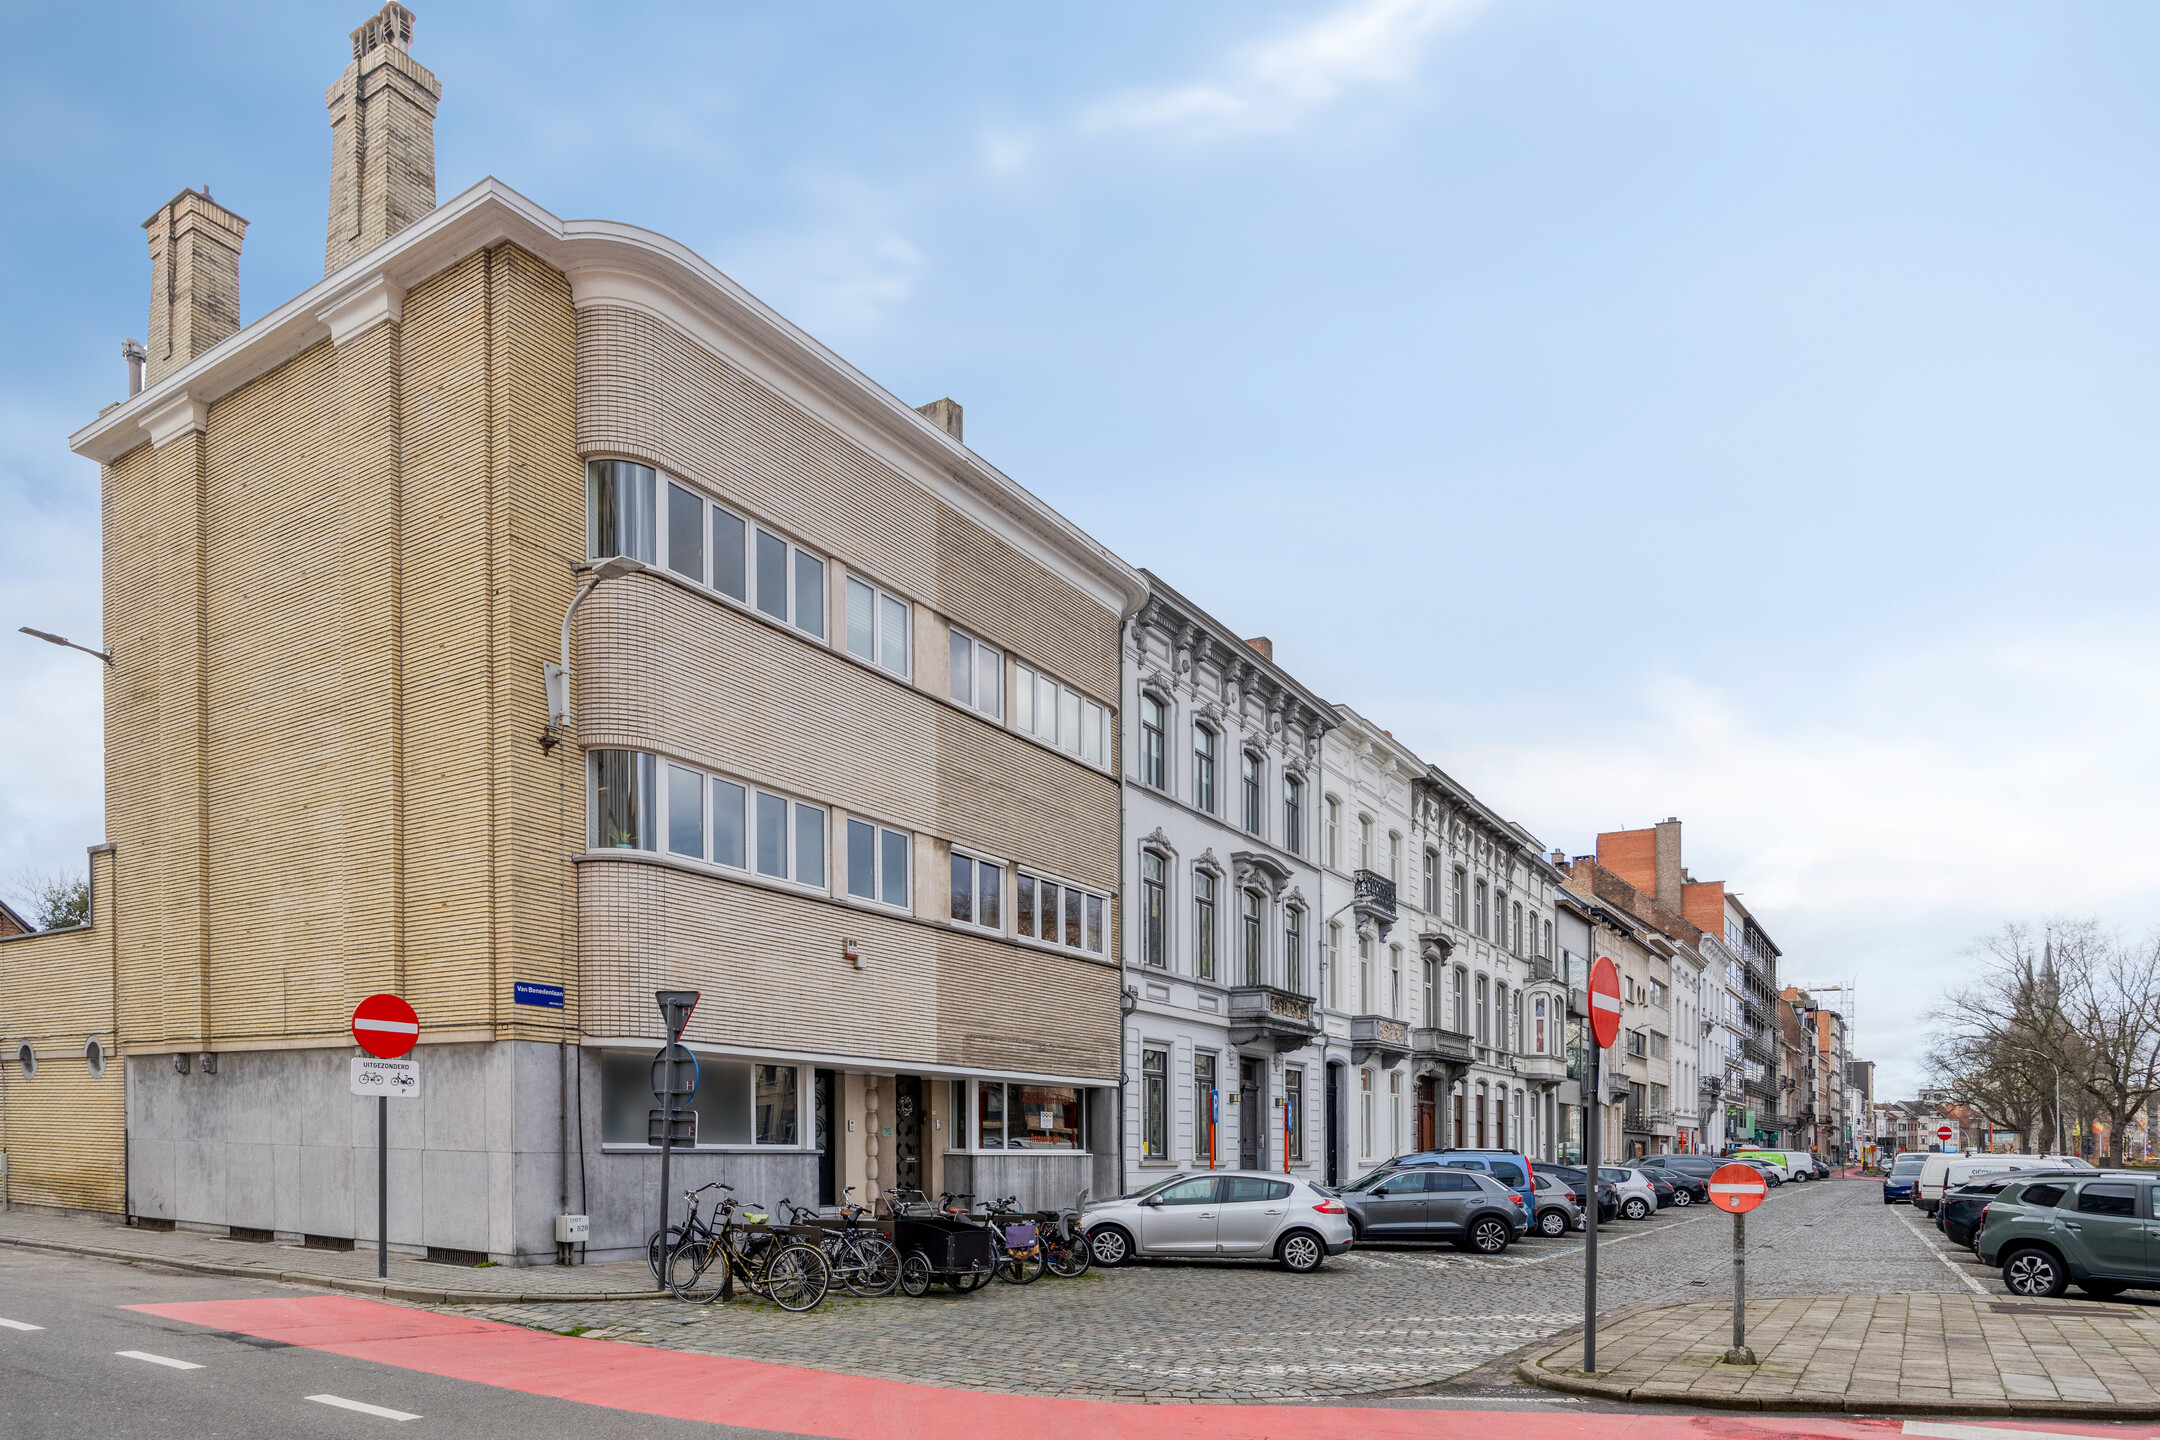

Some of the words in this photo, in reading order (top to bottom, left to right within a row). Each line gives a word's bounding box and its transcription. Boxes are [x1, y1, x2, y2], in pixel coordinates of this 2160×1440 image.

[516, 985, 528, 993] Van
[528, 986, 564, 997] Benedenlaan
[363, 1061, 410, 1070] UITGEZONDERD
